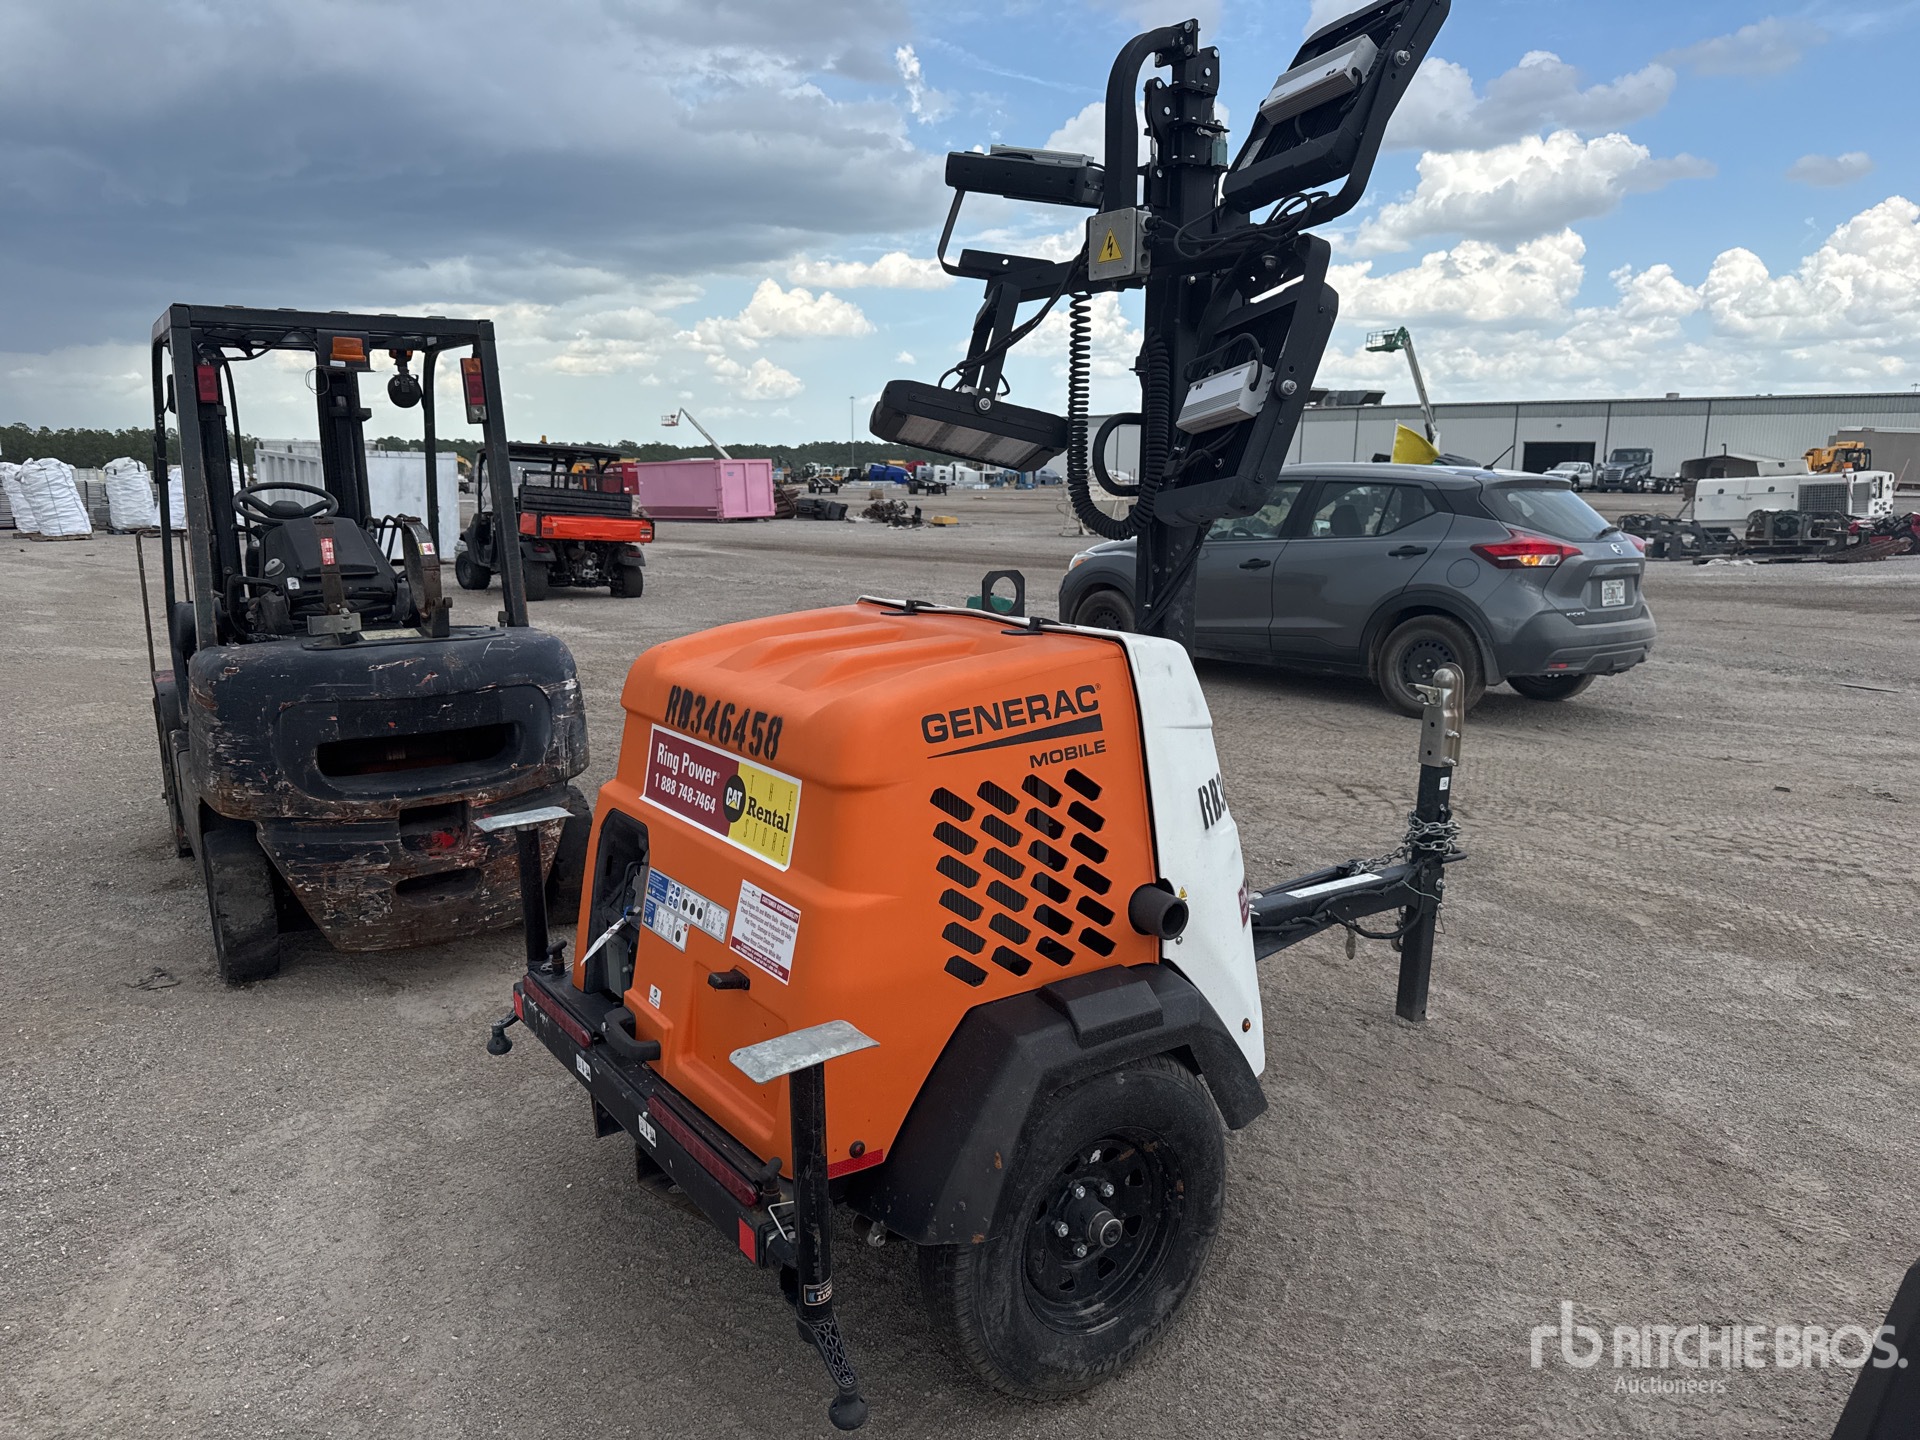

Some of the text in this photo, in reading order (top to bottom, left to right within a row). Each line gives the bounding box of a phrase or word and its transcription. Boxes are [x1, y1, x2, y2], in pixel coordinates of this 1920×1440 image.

[921, 684, 1099, 744] GENERAC
[657, 742, 717, 787] Ring Power
[1029, 740, 1106, 769] MOBILE
[655, 773, 717, 814] 1 888 748-7464
[725, 786, 791, 834] CAT Rental
